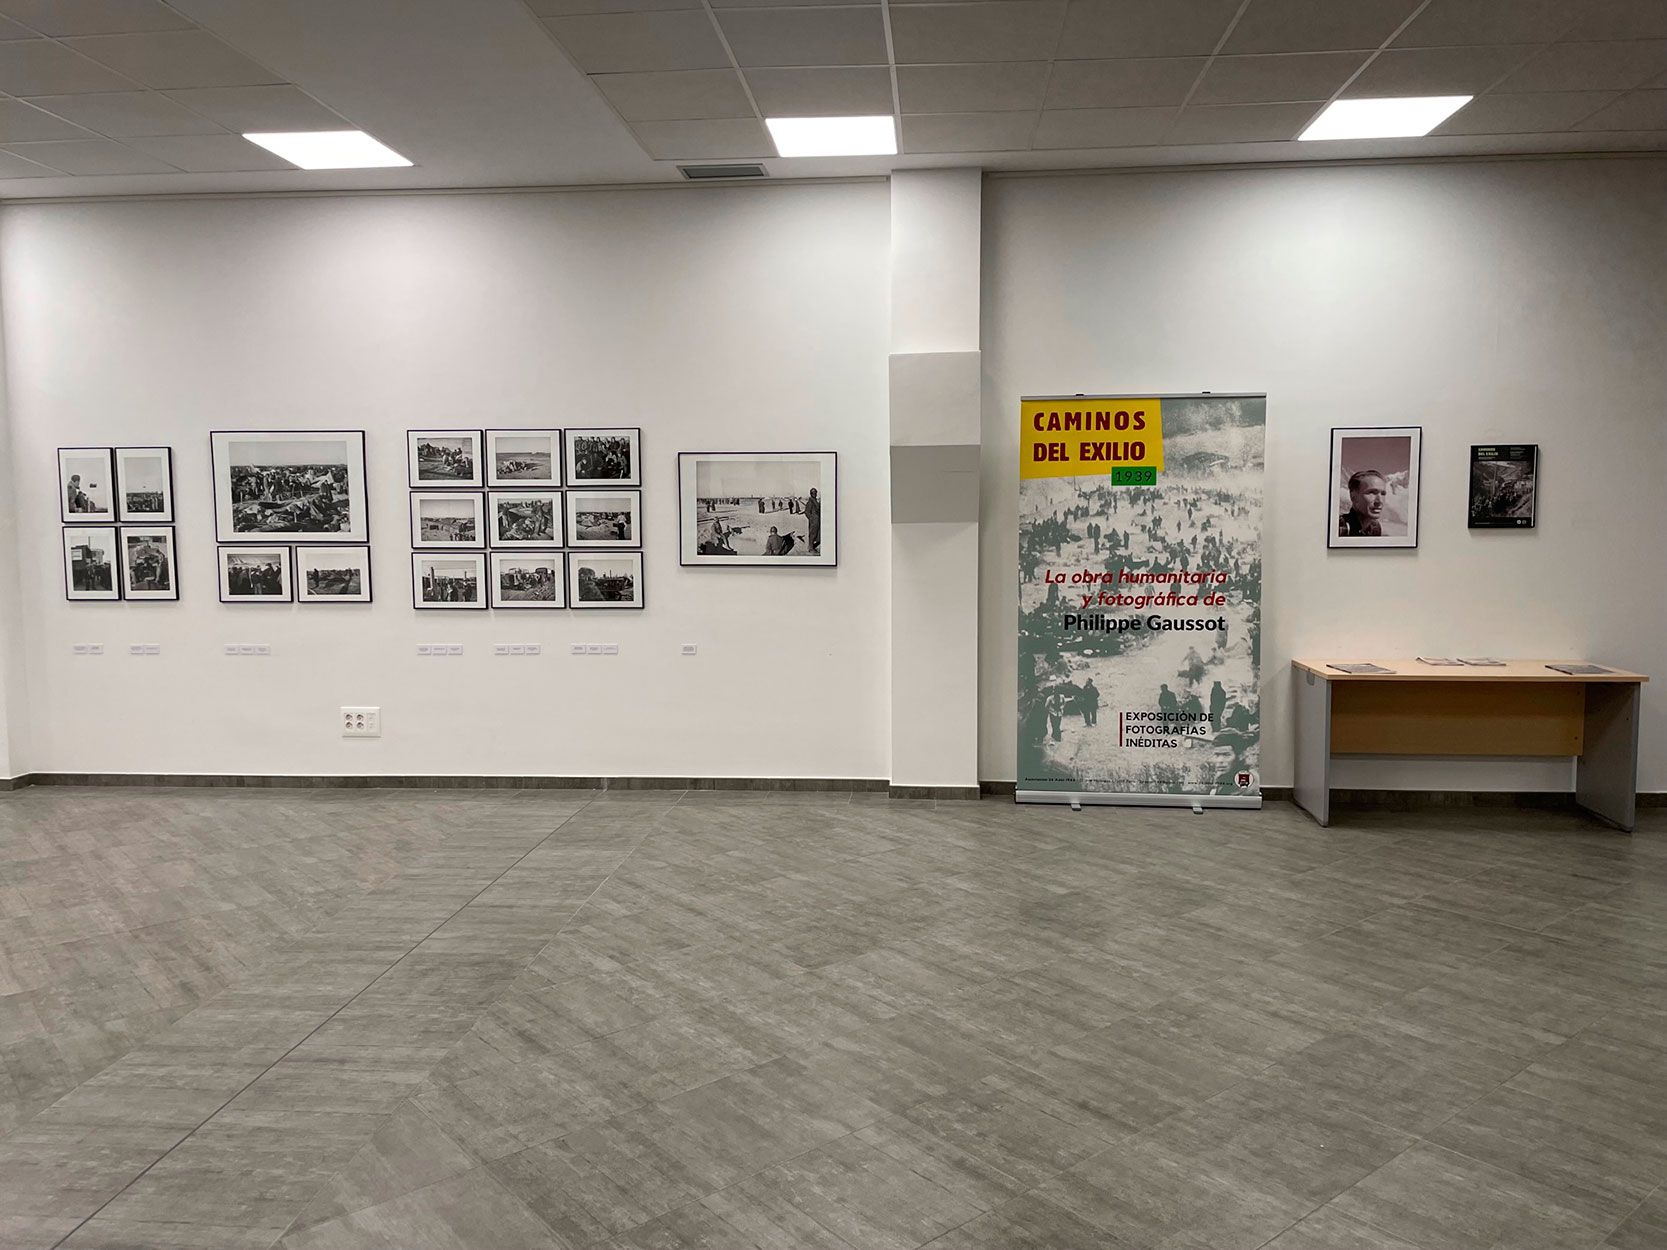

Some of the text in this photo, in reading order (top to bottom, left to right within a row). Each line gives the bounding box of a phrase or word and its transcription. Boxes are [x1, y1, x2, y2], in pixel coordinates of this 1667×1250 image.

[1033, 411, 1146, 431] CAMINOS
[1033, 441, 1146, 462] DEL EXILIO
[1115, 470, 1152, 482] 1939
[1045, 568, 1227, 584] La obra humanitaria
[1081, 592, 1226, 609] y fotográfica de
[1064, 614, 1226, 634] Philippe Gaussot
[1125, 710, 1214, 722] EXPOSICIÓN DE
[1125, 724, 1206, 735] FOTOGRAFÍAS
[1125, 736, 1178, 748] INÉDITAS
